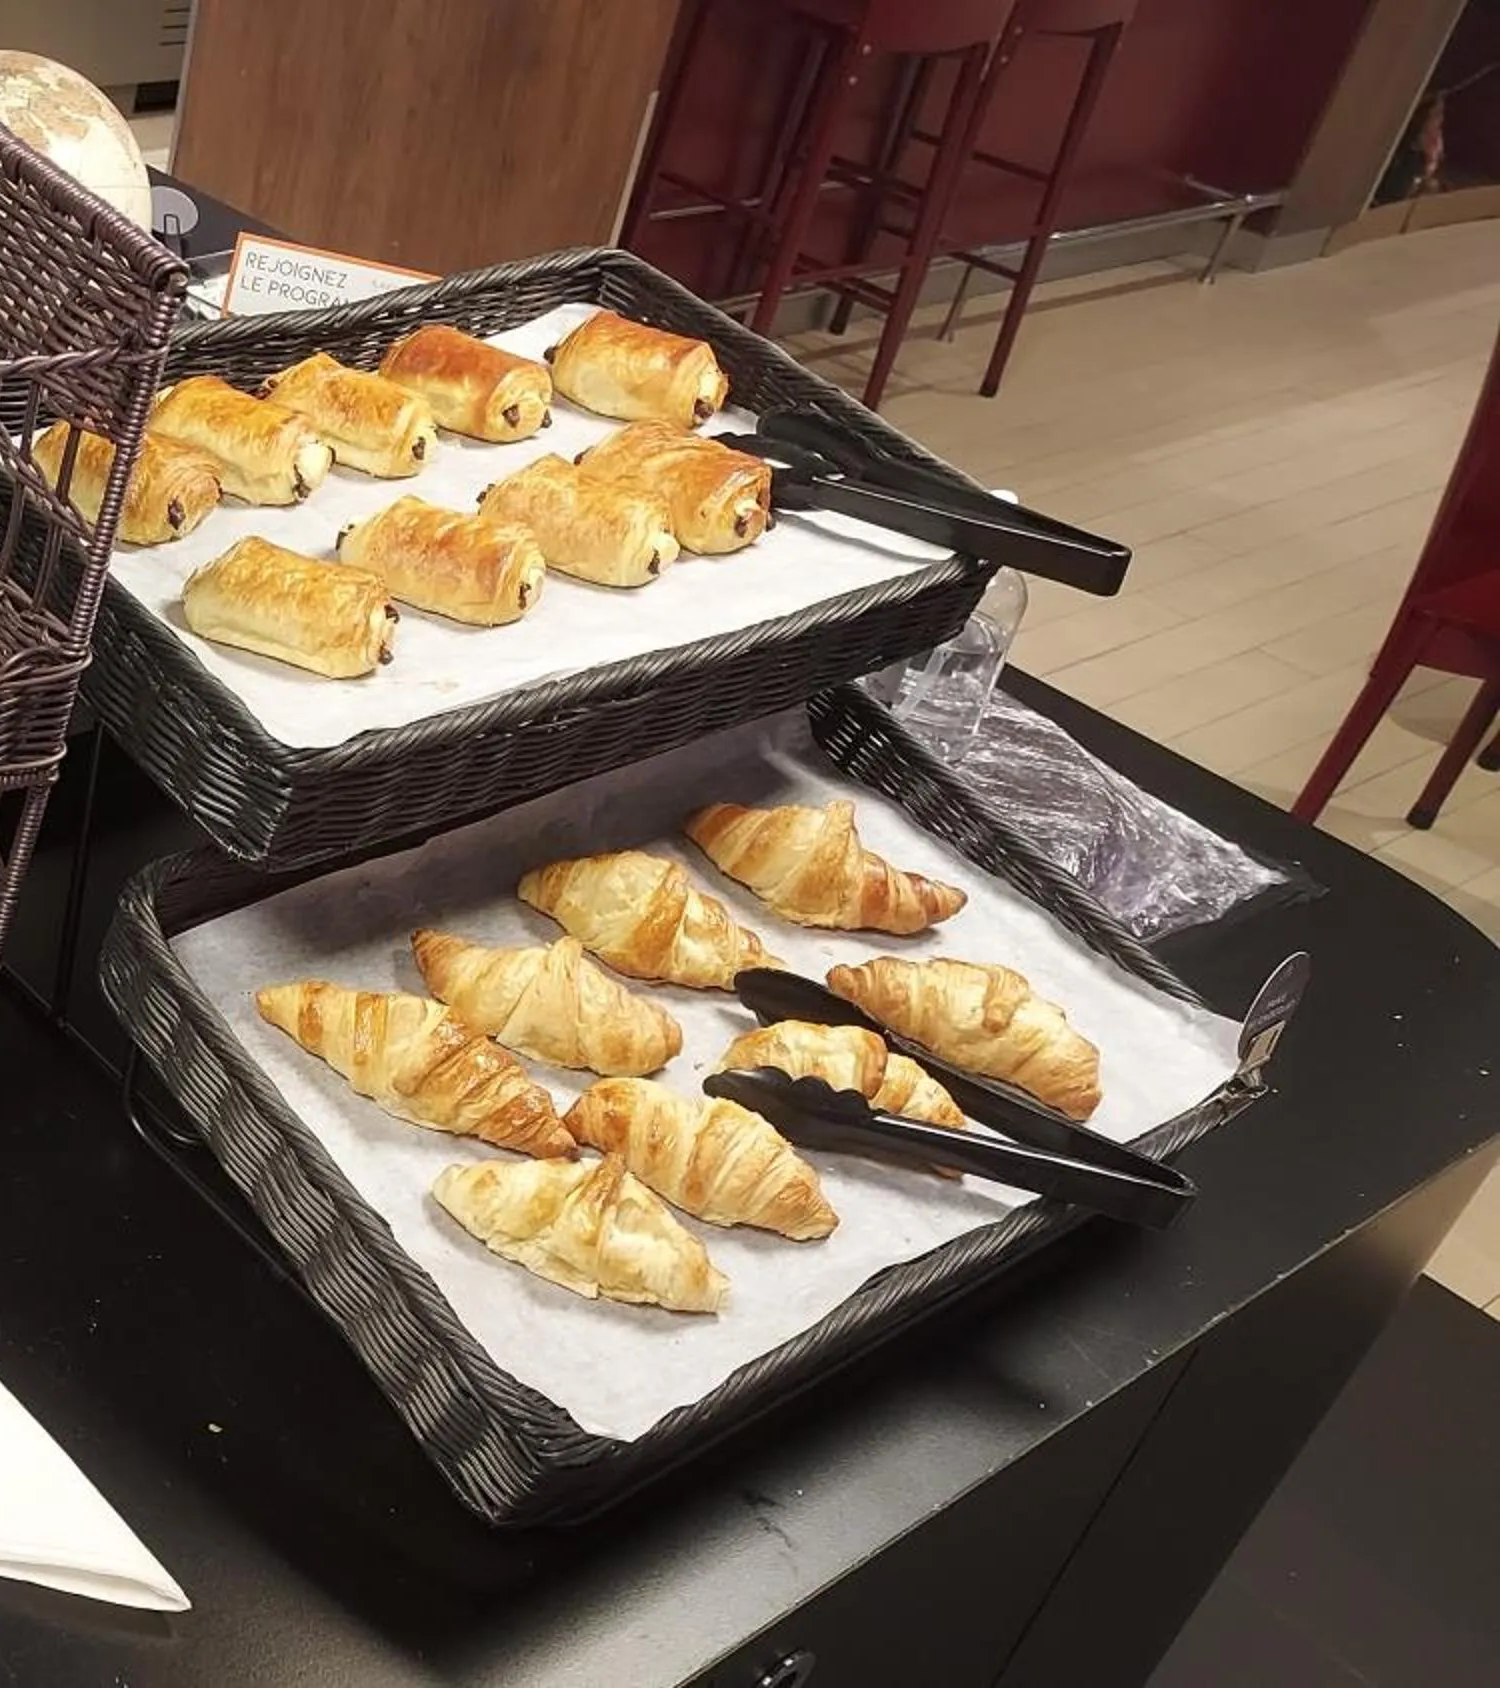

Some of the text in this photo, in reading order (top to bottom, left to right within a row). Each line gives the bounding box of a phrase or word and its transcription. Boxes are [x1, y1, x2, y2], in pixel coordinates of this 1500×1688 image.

[245, 251, 348, 290] REJOIGNEZ
[239, 276, 263, 293] LE
[267, 280, 350, 307] PROGRA
